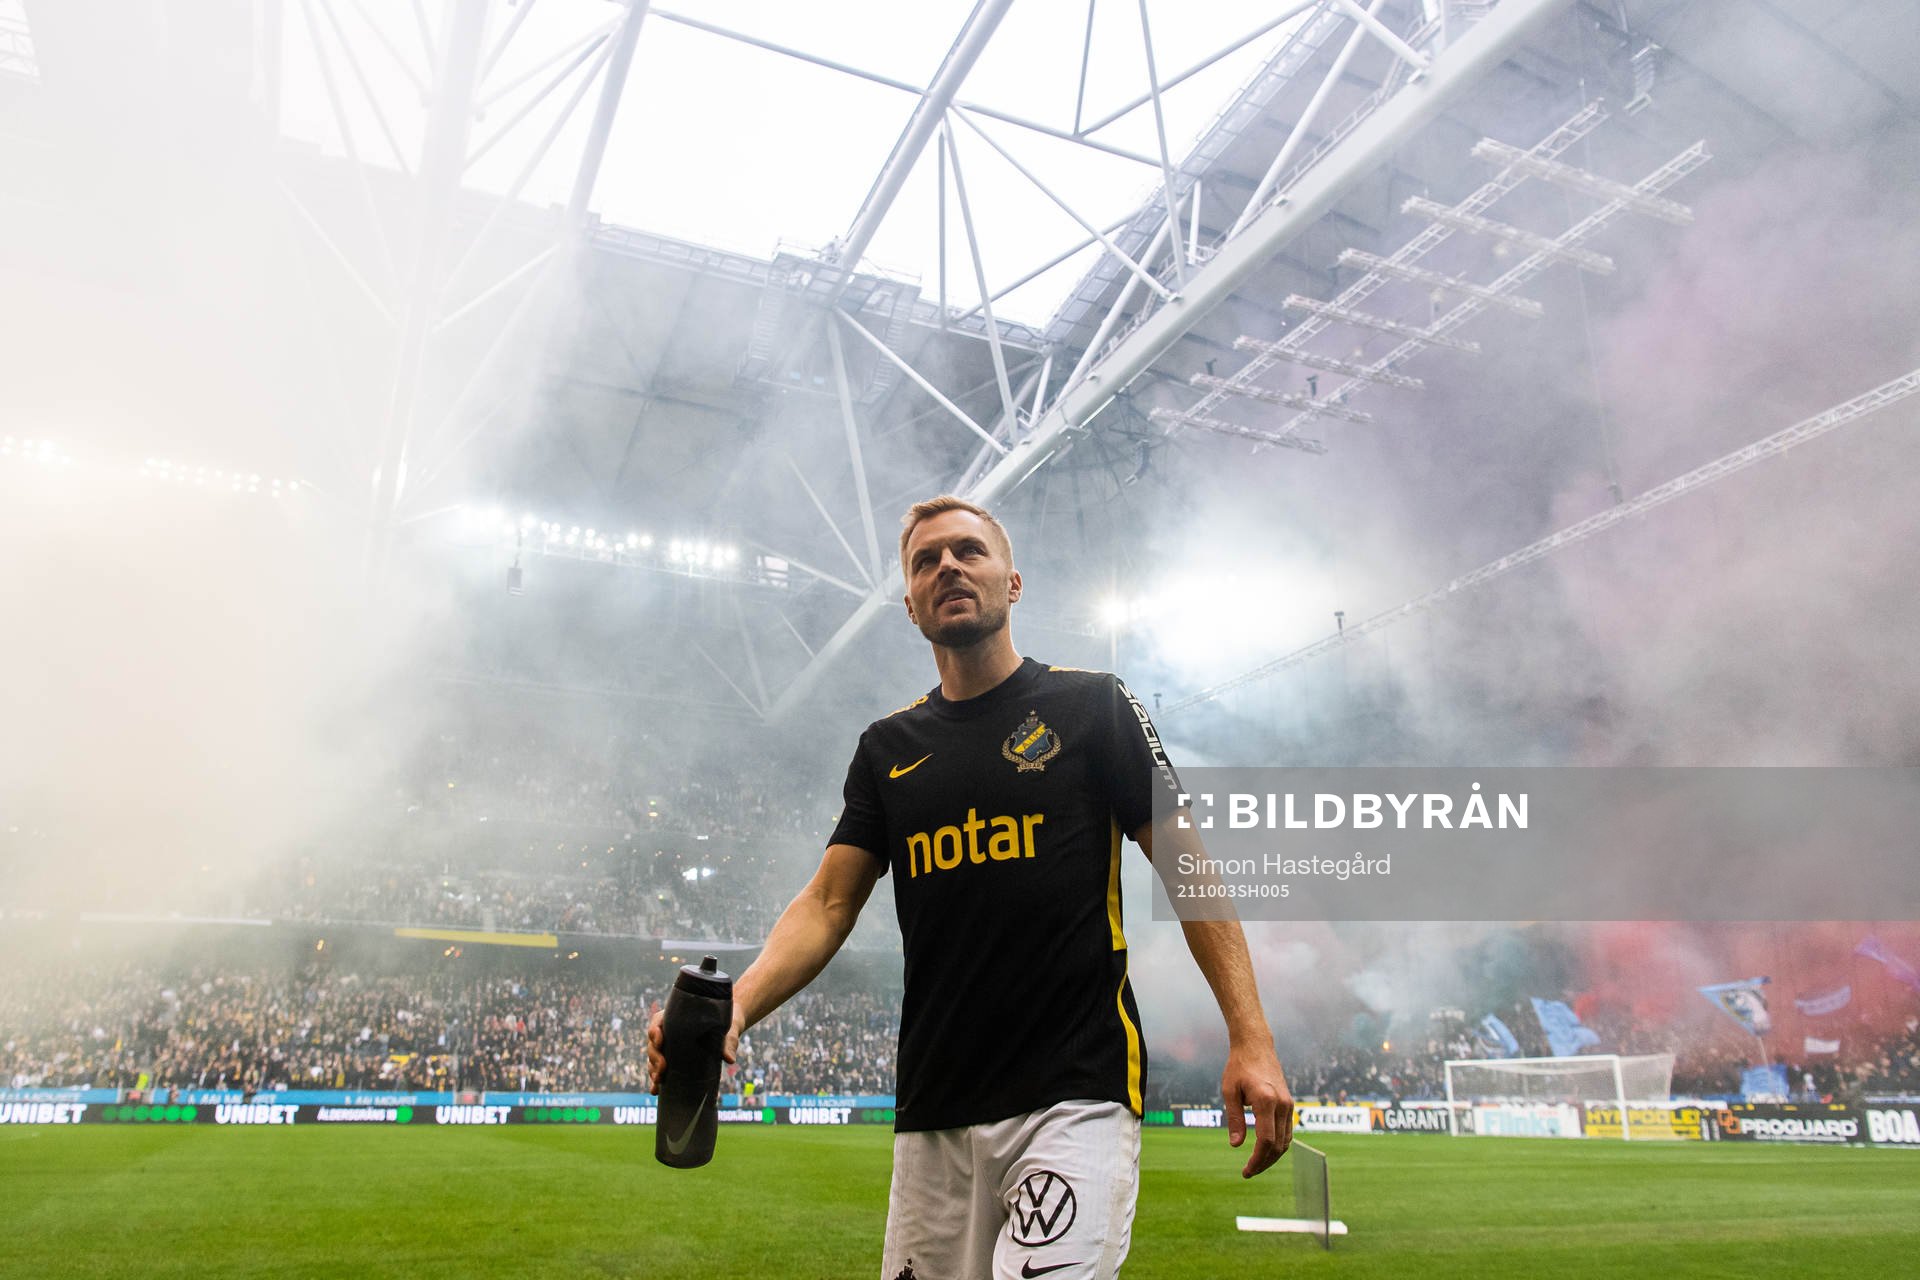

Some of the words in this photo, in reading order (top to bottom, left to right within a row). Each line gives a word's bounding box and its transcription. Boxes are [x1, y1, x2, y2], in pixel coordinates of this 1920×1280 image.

[906, 808, 1044, 878] notar
[0, 1103, 87, 1124] UNIBET
[215, 1104, 299, 1124] UNIBET
[436, 1106, 511, 1124] UNIBET
[789, 1108, 851, 1124] UNIBET
[1182, 1109, 1223, 1127] UNIBET
[1307, 1112, 1361, 1125] AXELENT
